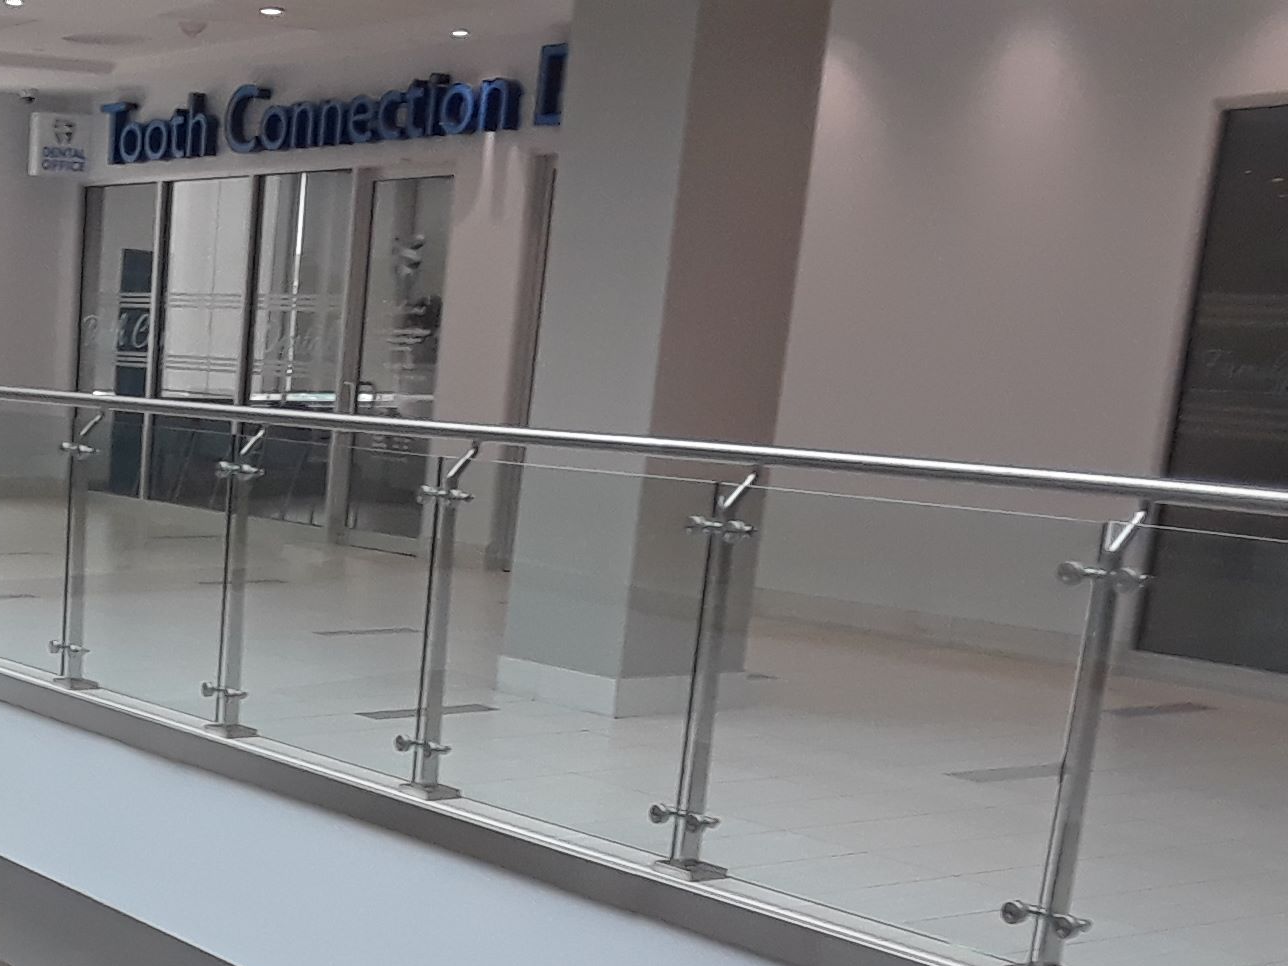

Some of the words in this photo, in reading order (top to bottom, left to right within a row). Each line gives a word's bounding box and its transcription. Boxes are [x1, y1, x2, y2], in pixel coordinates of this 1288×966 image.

[100, 92, 218, 165] Tooth
[224, 72, 524, 154] Connection
[43, 146, 85, 160] DENTAL
[41, 159, 85, 172] OFFICE
